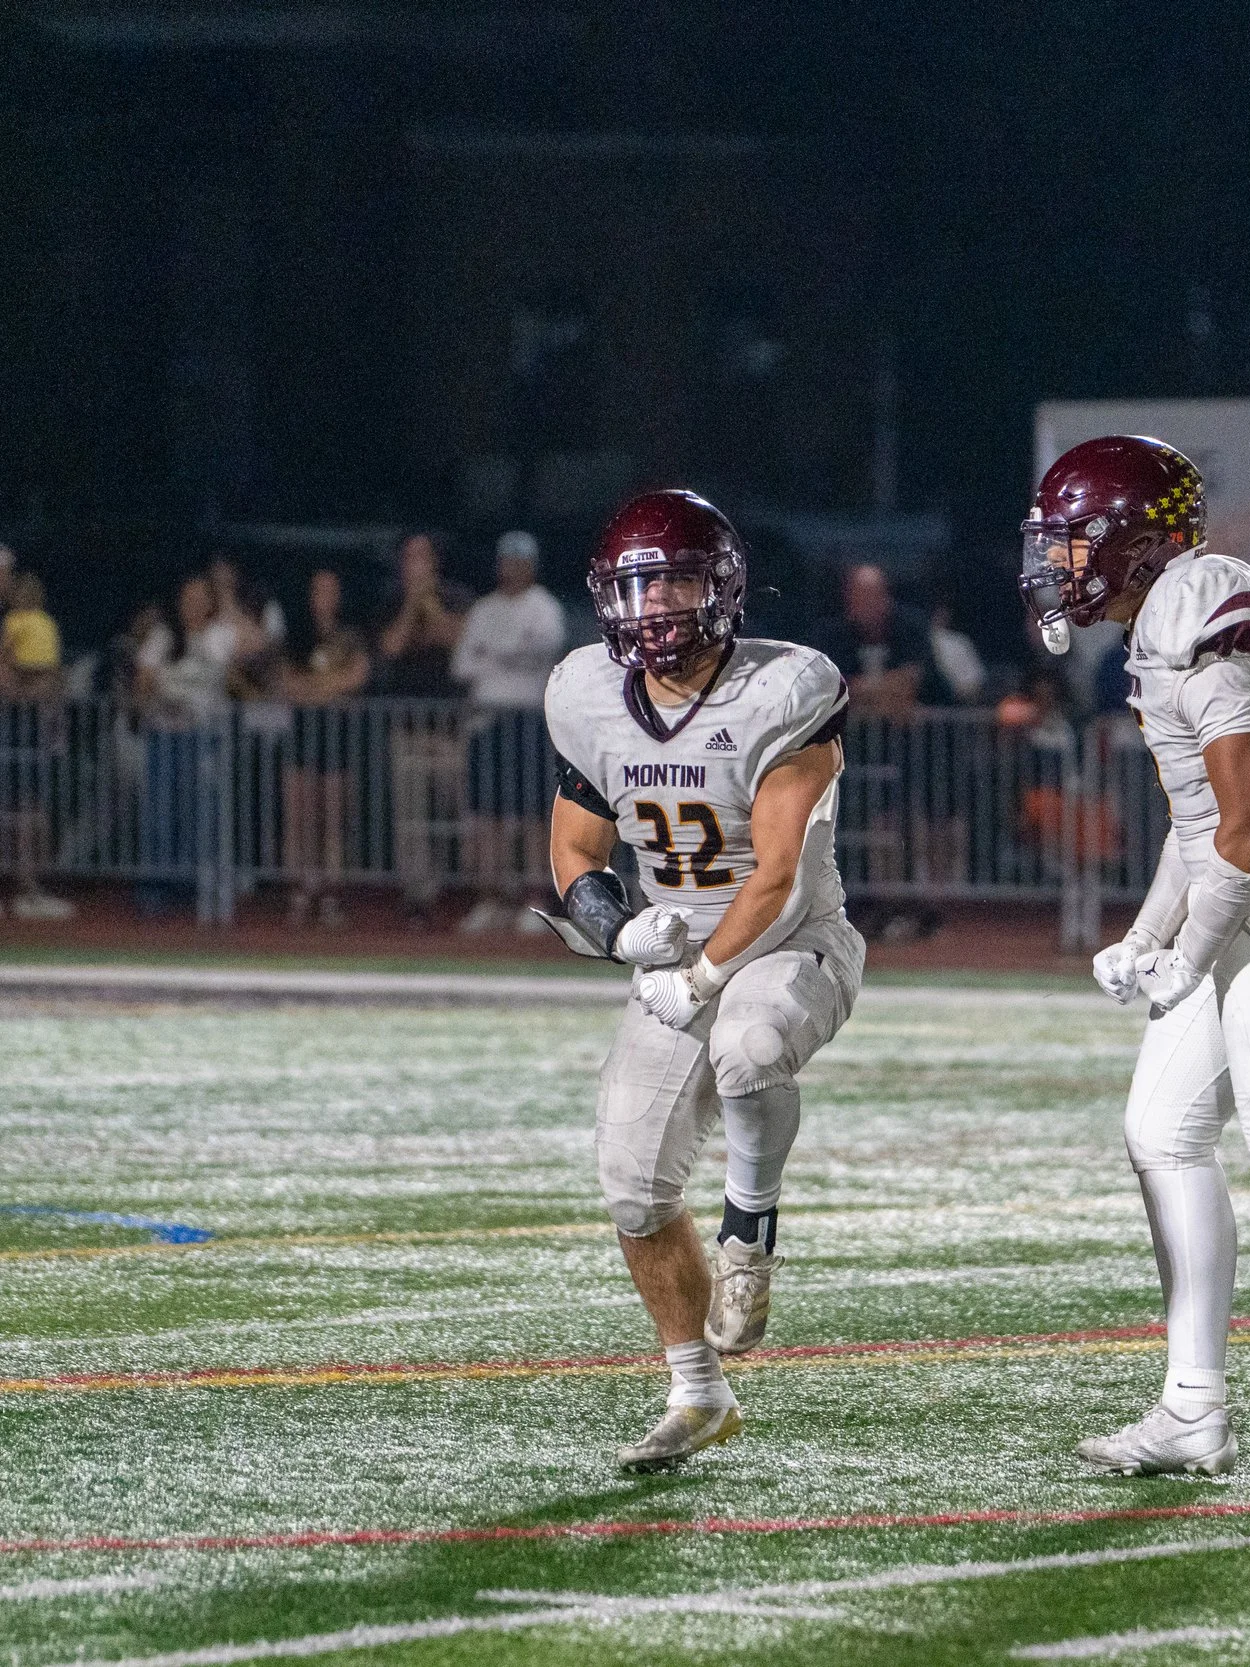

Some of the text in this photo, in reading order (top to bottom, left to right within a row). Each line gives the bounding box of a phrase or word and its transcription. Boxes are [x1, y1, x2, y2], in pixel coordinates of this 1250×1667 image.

[705, 741, 738, 751] adidas
[623, 764, 706, 788] MONTINI
[634, 801, 736, 889] 32
